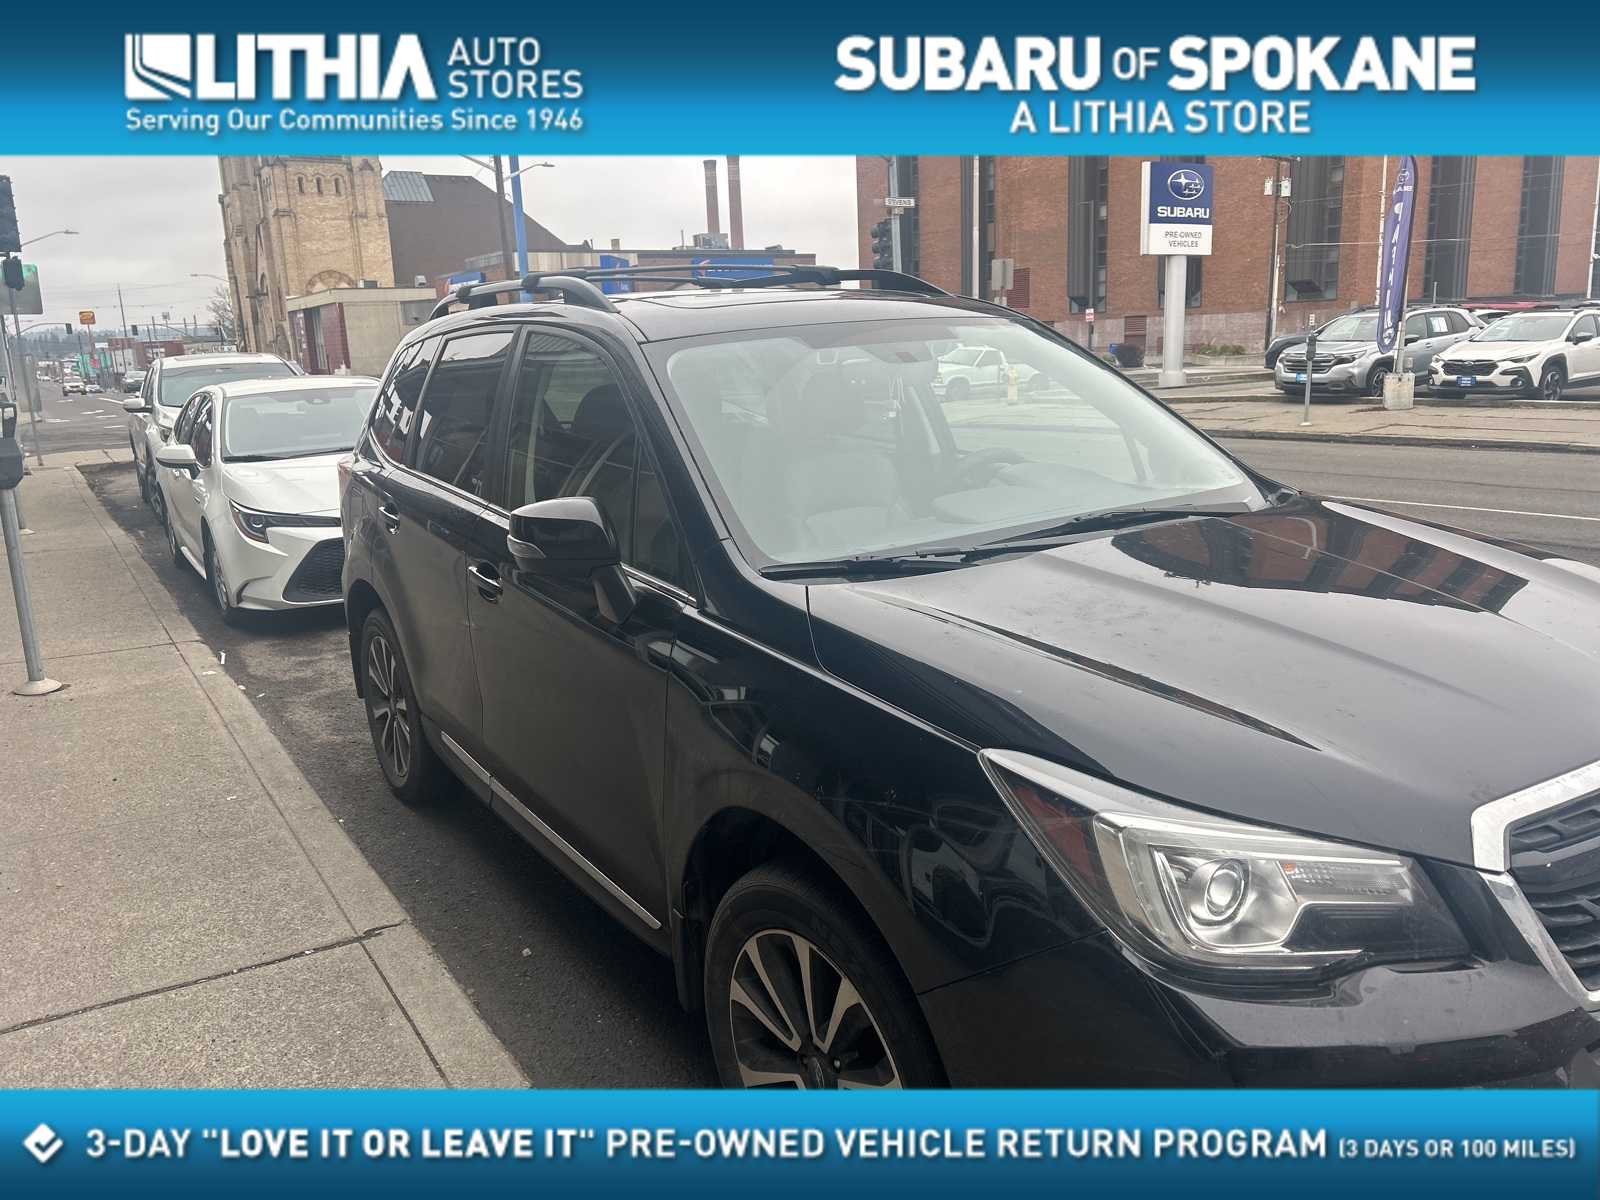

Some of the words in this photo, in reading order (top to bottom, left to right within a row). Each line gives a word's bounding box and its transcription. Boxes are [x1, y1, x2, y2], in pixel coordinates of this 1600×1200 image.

[1157, 206, 1210, 218] SUBARU
[1164, 231, 1202, 239] PRE-OWNED
[1168, 240, 1199, 248] VEHICLES
